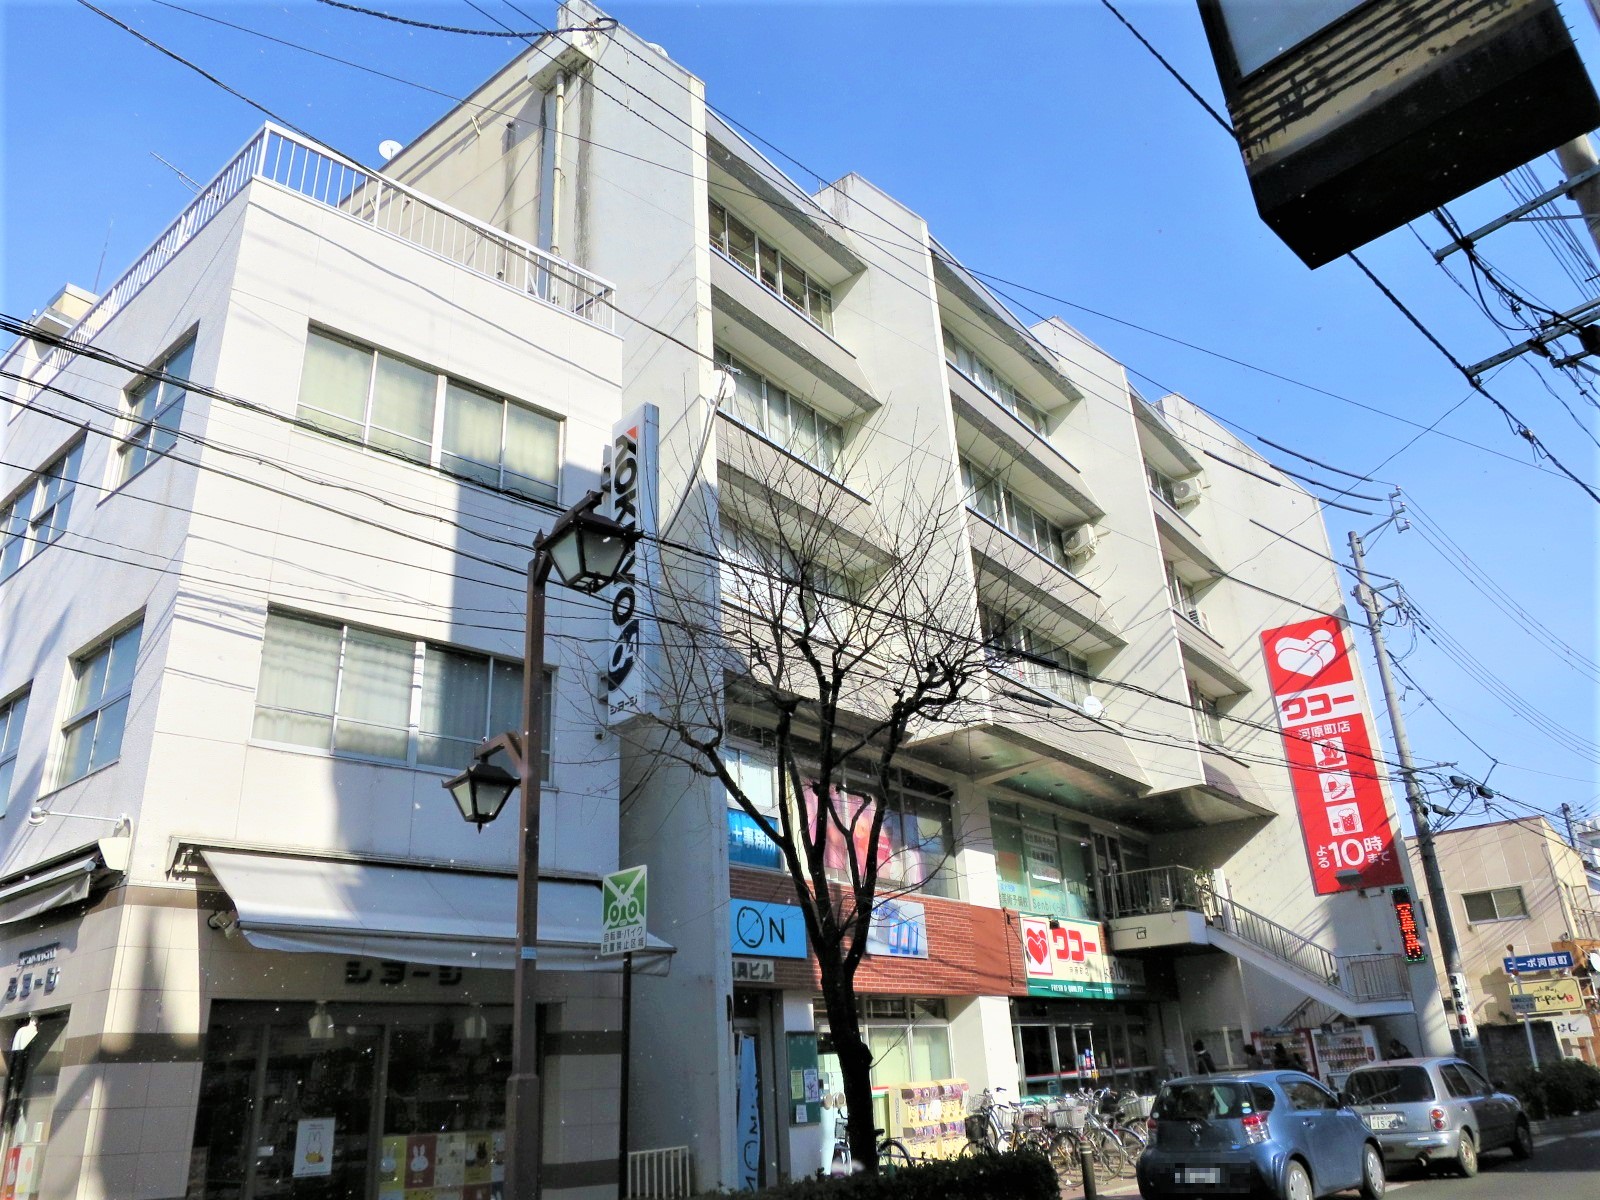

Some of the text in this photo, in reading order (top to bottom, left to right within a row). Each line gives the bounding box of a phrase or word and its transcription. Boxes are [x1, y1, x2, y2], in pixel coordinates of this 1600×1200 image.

[1281, 693, 1355, 721] ワコー
[1298, 720, 1351, 740] 河原町店
[728, 825, 776, 851] 士事務所
[1051, 927, 1097, 962] ワコー
